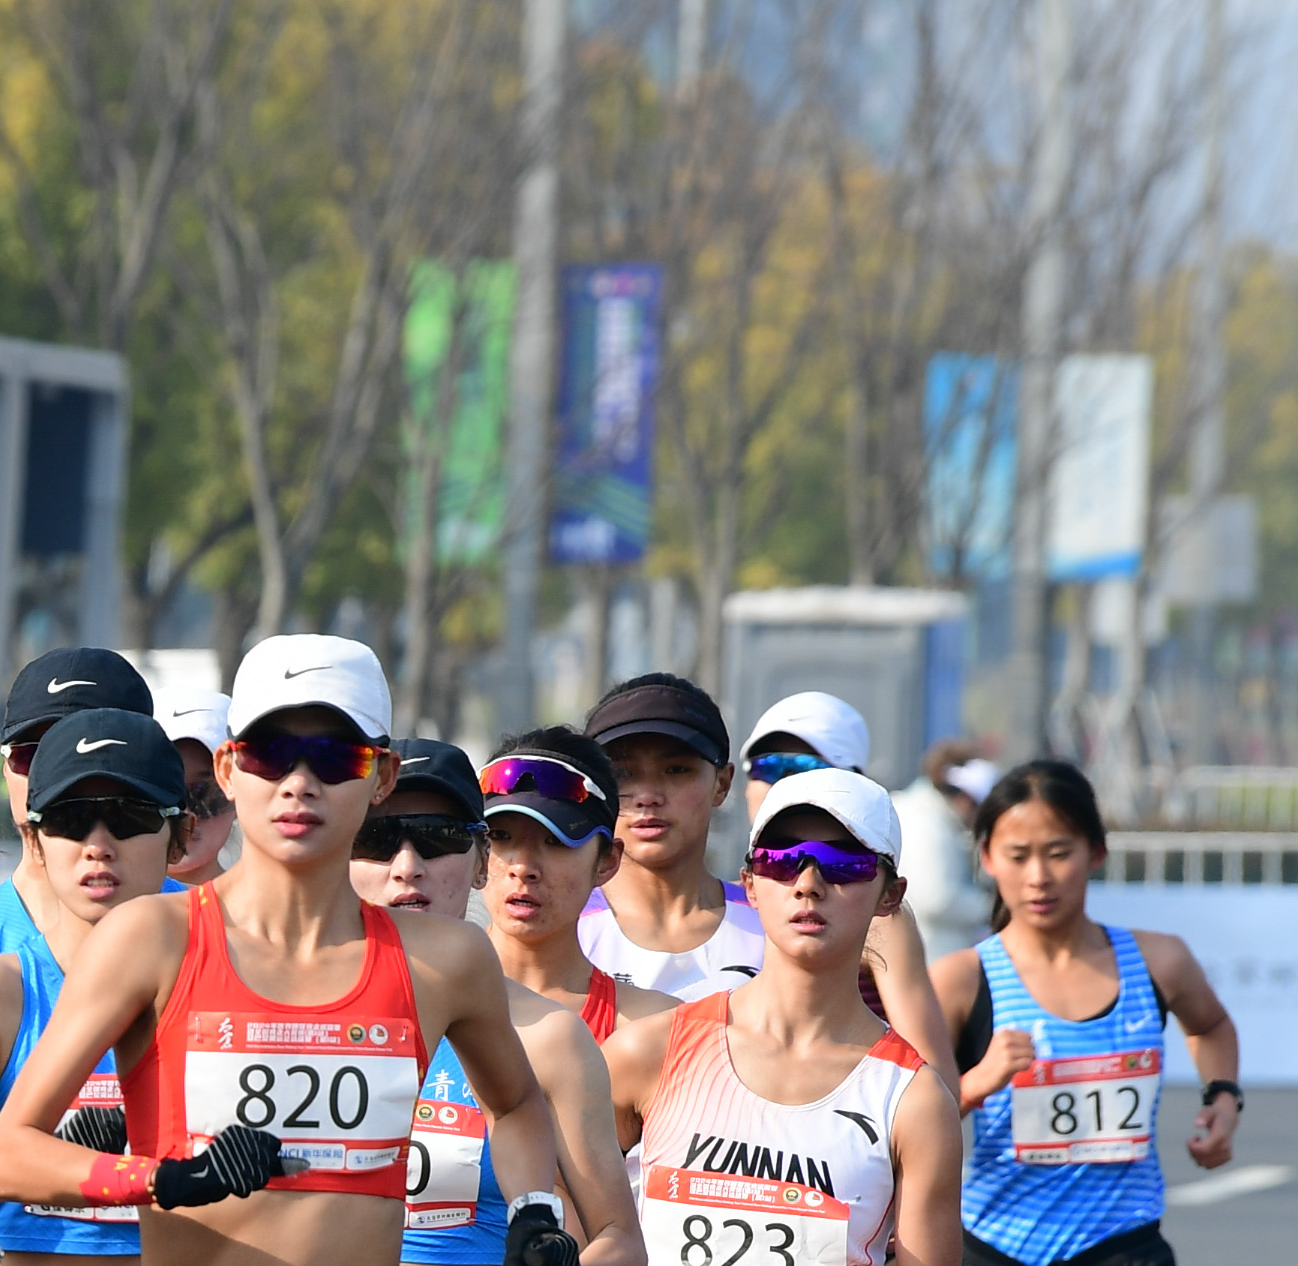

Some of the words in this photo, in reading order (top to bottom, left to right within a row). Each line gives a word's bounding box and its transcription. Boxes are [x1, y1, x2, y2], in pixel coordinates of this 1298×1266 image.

[236, 1063, 369, 1130] 820
[1050, 1086, 1143, 1135] 812
[681, 1133, 835, 1198] YUNNAN
